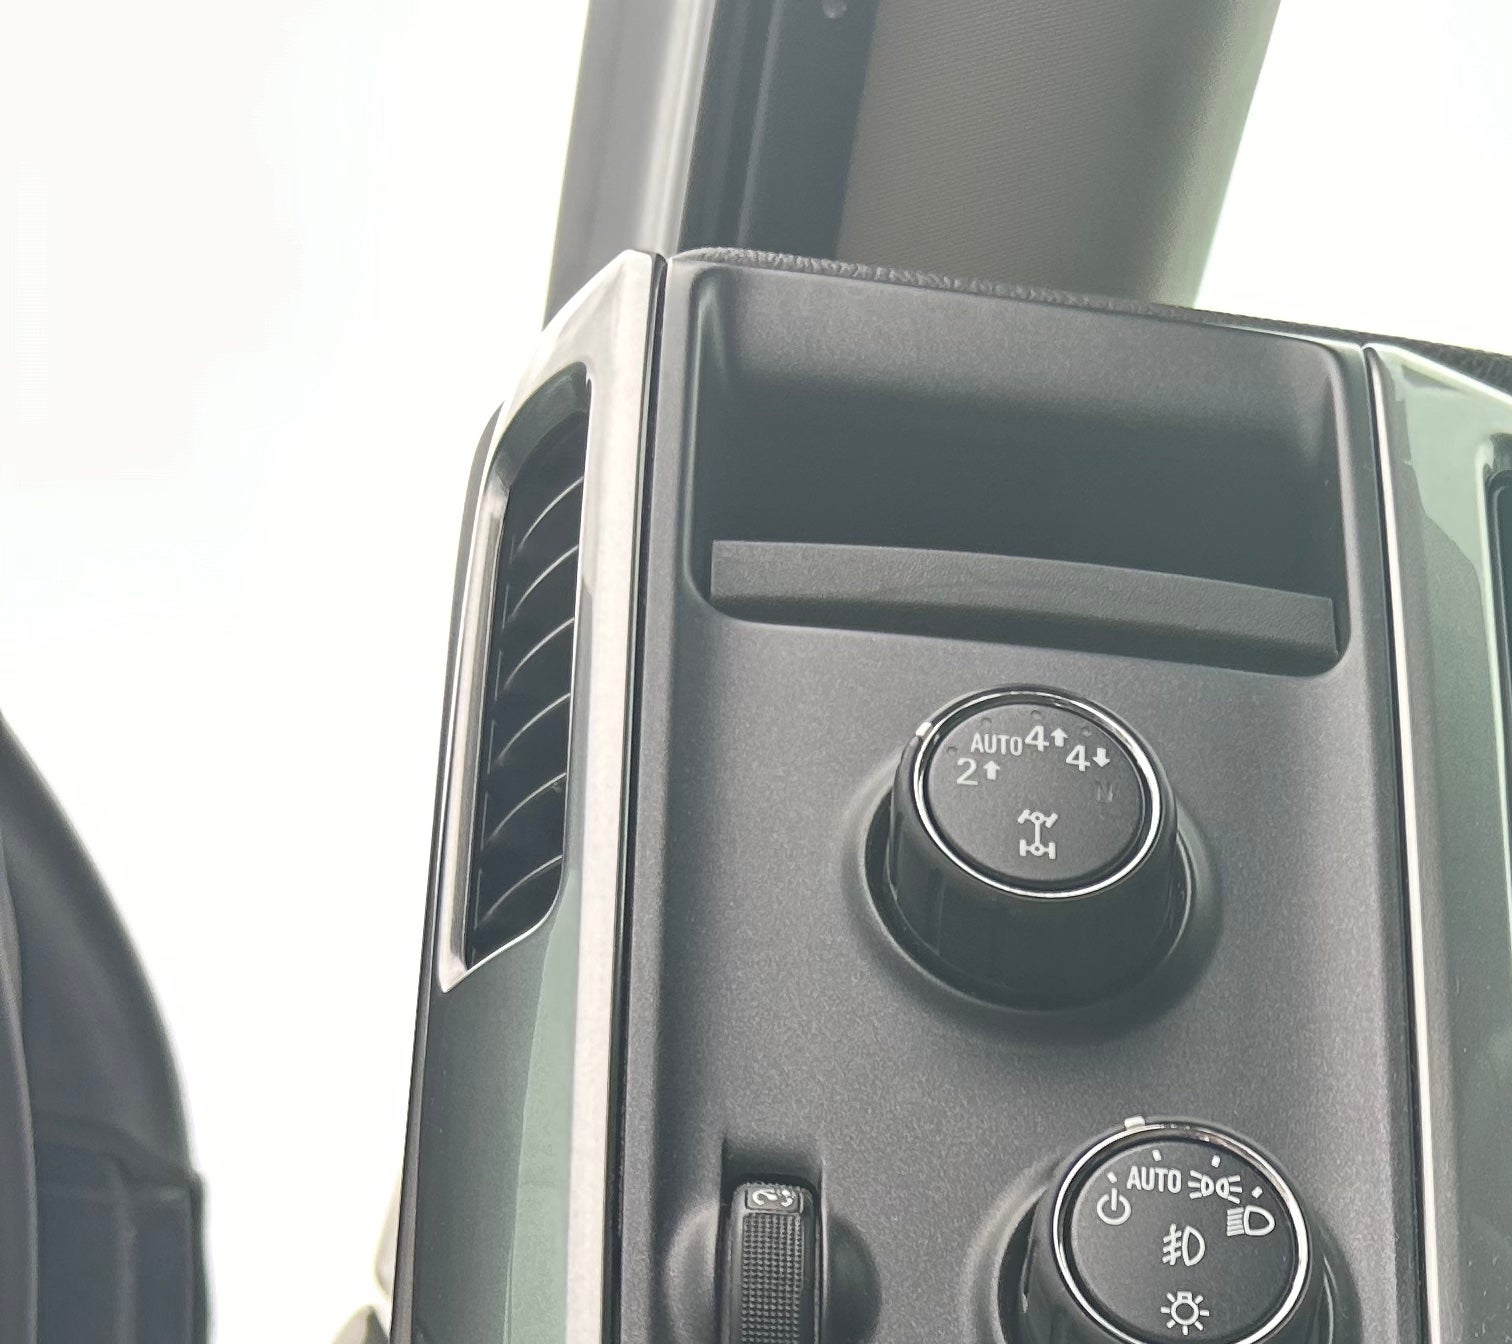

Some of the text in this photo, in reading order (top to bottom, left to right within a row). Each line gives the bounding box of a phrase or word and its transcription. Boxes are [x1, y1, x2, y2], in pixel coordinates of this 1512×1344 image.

[970, 732, 1023, 757] AUTO
[1024, 725, 1050, 752] 4
[956, 758, 979, 786] 2
[1065, 744, 1091, 772] 4
[1126, 1166, 1182, 1194] AUTO
